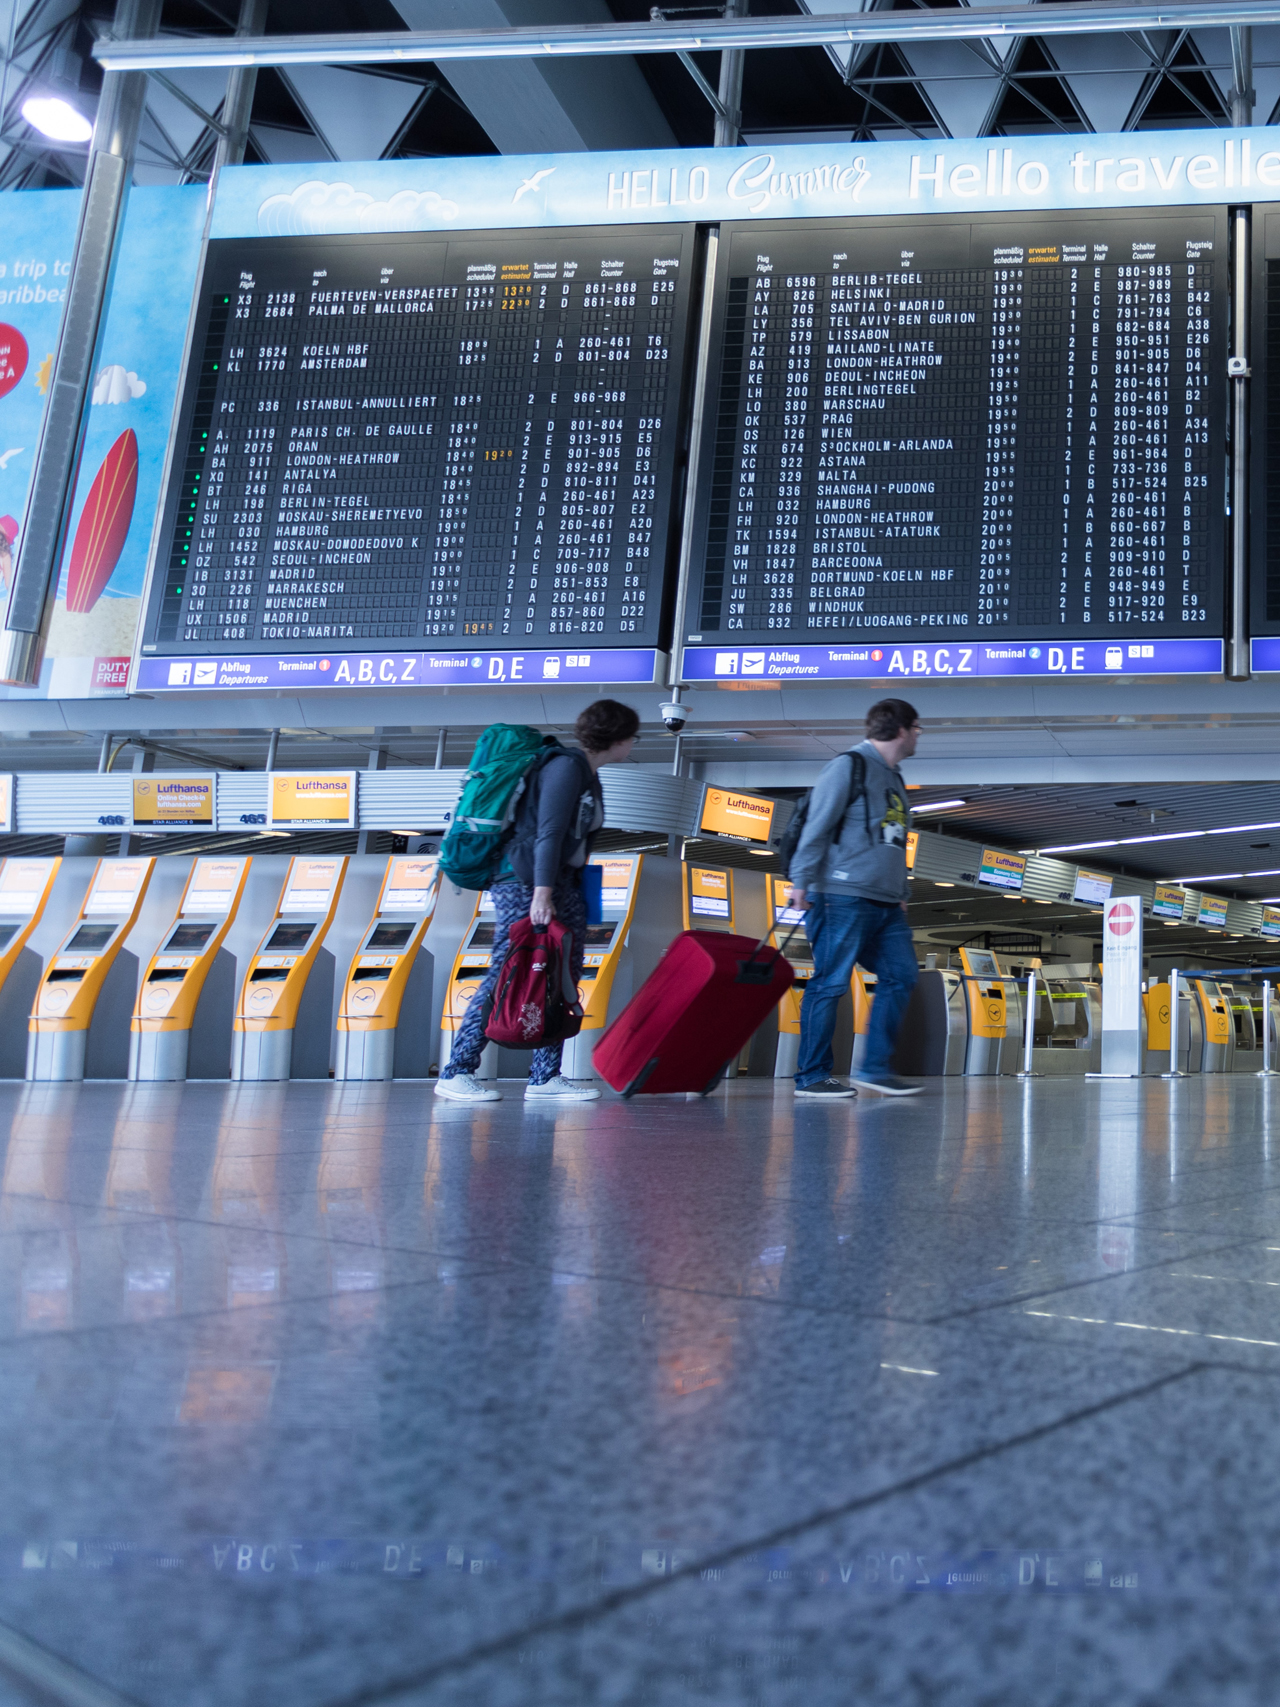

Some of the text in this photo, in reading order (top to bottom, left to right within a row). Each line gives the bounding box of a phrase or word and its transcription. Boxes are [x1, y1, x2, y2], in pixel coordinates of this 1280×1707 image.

[607, 164, 709, 210] HELLO
[727, 154, 871, 213] Summer
[909, 147, 1049, 199] Hello
[13, 260, 47, 280] trip
[236, 280, 674, 305] X3 2138 FUERTEVEN-VERSPAETET 861-868 E25
[308, 301, 433, 315] PALMA DE MALLORCA
[751, 318, 1209, 343] TP 579 LISSABON 682-684 A38
[824, 368, 926, 382] DEOUL-INCHEON
[211, 445, 651, 468] BA 911 LONDON-HEATHROW 901-905 D6
[816, 481, 935, 496] SHANGHAI-PUDONG
[277, 507, 422, 522] MOSKAU-SHEREMETYEVO
[735, 524, 940, 541] TK 1594 ISTANBUL-ATATURK
[727, 608, 1206, 629] CA 932 HEFEI/LUOGANG-PEKING 517-524 B23
[262, 625, 353, 638] TOKIO-NARITA
[769, 652, 799, 663] Abflug
[828, 651, 868, 660] Terminal
[985, 649, 1025, 658] Terminal
[98, 662, 129, 673] DUTY
[221, 662, 250, 673] Abflug
[278, 661, 316, 670] Terminal
[429, 658, 468, 667] Terminal
[768, 665, 819, 675] Departures
[97, 673, 126, 683] FREE
[219, 675, 268, 685] Departures
[157, 784, 209, 793] Lufthansa
[296, 781, 347, 790] Lufthansa
[727, 797, 770, 814] Lufthansa
[240, 814, 267, 824] 465
[995, 856, 1023, 869] Lufthansa
[702, 872, 725, 880] Lufthansa
[961, 872, 975, 882] 461
